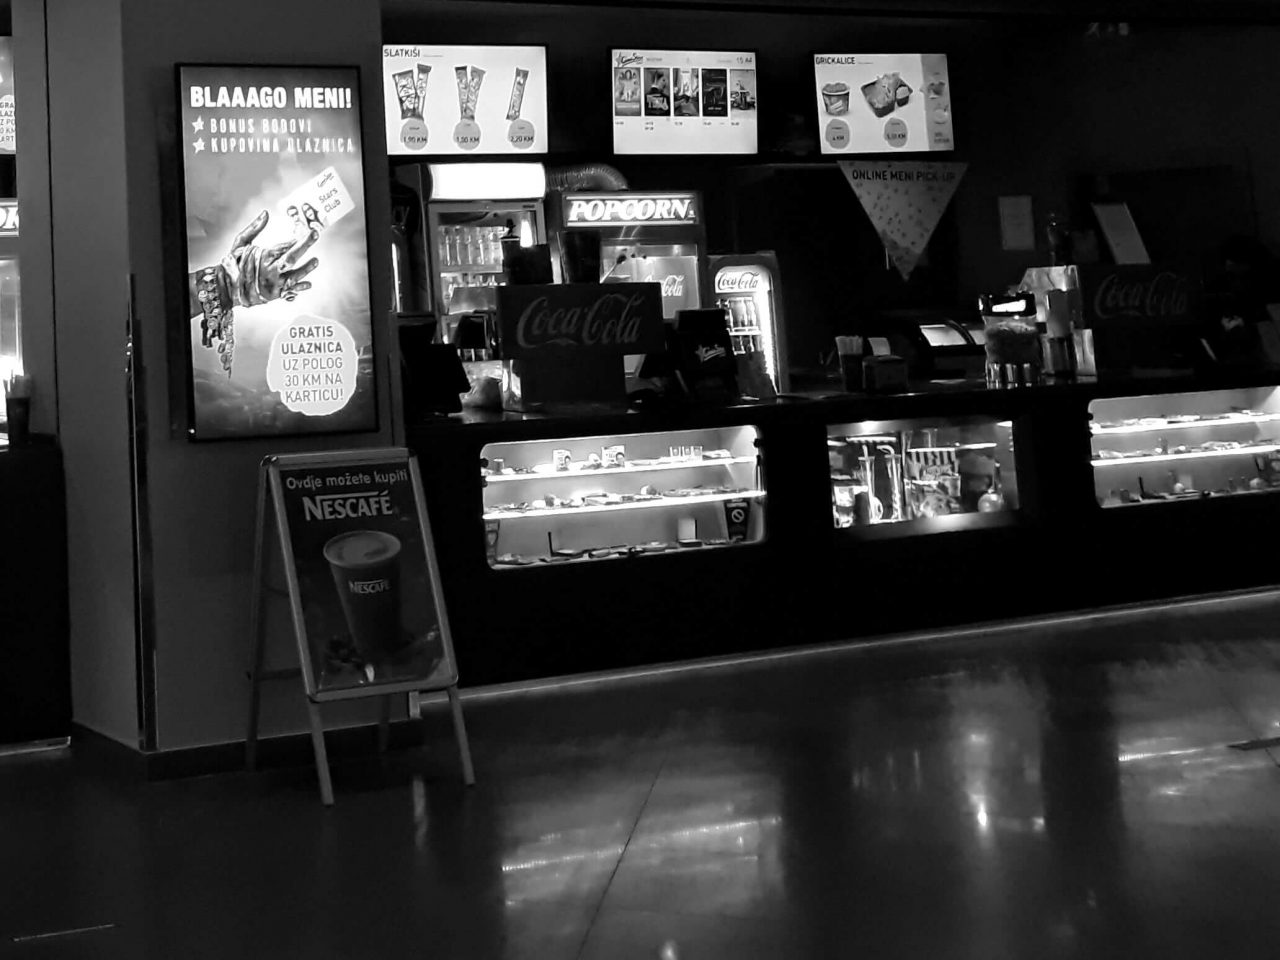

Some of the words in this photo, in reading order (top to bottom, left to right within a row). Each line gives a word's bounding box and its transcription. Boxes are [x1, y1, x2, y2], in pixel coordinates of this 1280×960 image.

[384, 48, 420, 58] SLATKIŠI
[816, 57, 855, 65] GRICKALICE
[190, 86, 287, 108] BLAAAGO
[294, 88, 352, 109] MENI!
[210, 118, 254, 133] BONUS
[262, 118, 311, 133] BODOVI
[211, 138, 279, 153] KUPOVINA
[287, 138, 354, 152] ULAZNICA
[852, 169, 887, 181] ONLINE
[890, 170, 914, 182] MENI
[324, 198, 341, 213] Club
[569, 200, 690, 222] POPCORN
[517, 293, 645, 349] Coca-Cola
[289, 326, 333, 339] GRATIS
[281, 341, 343, 355] ULAZNICA
[283, 359, 298, 371] UZ
[303, 357, 343, 370] POLOG
[285, 374, 299, 387] 30
[302, 373, 321, 386] KM
[325, 372, 343, 385] NA
[285, 388, 344, 403] KARTICU!
[286, 474, 323, 490] Ovdje
[326, 472, 371, 488] možete
[374, 468, 409, 484] kupiti
[302, 489, 393, 521] NESCAFÉ
